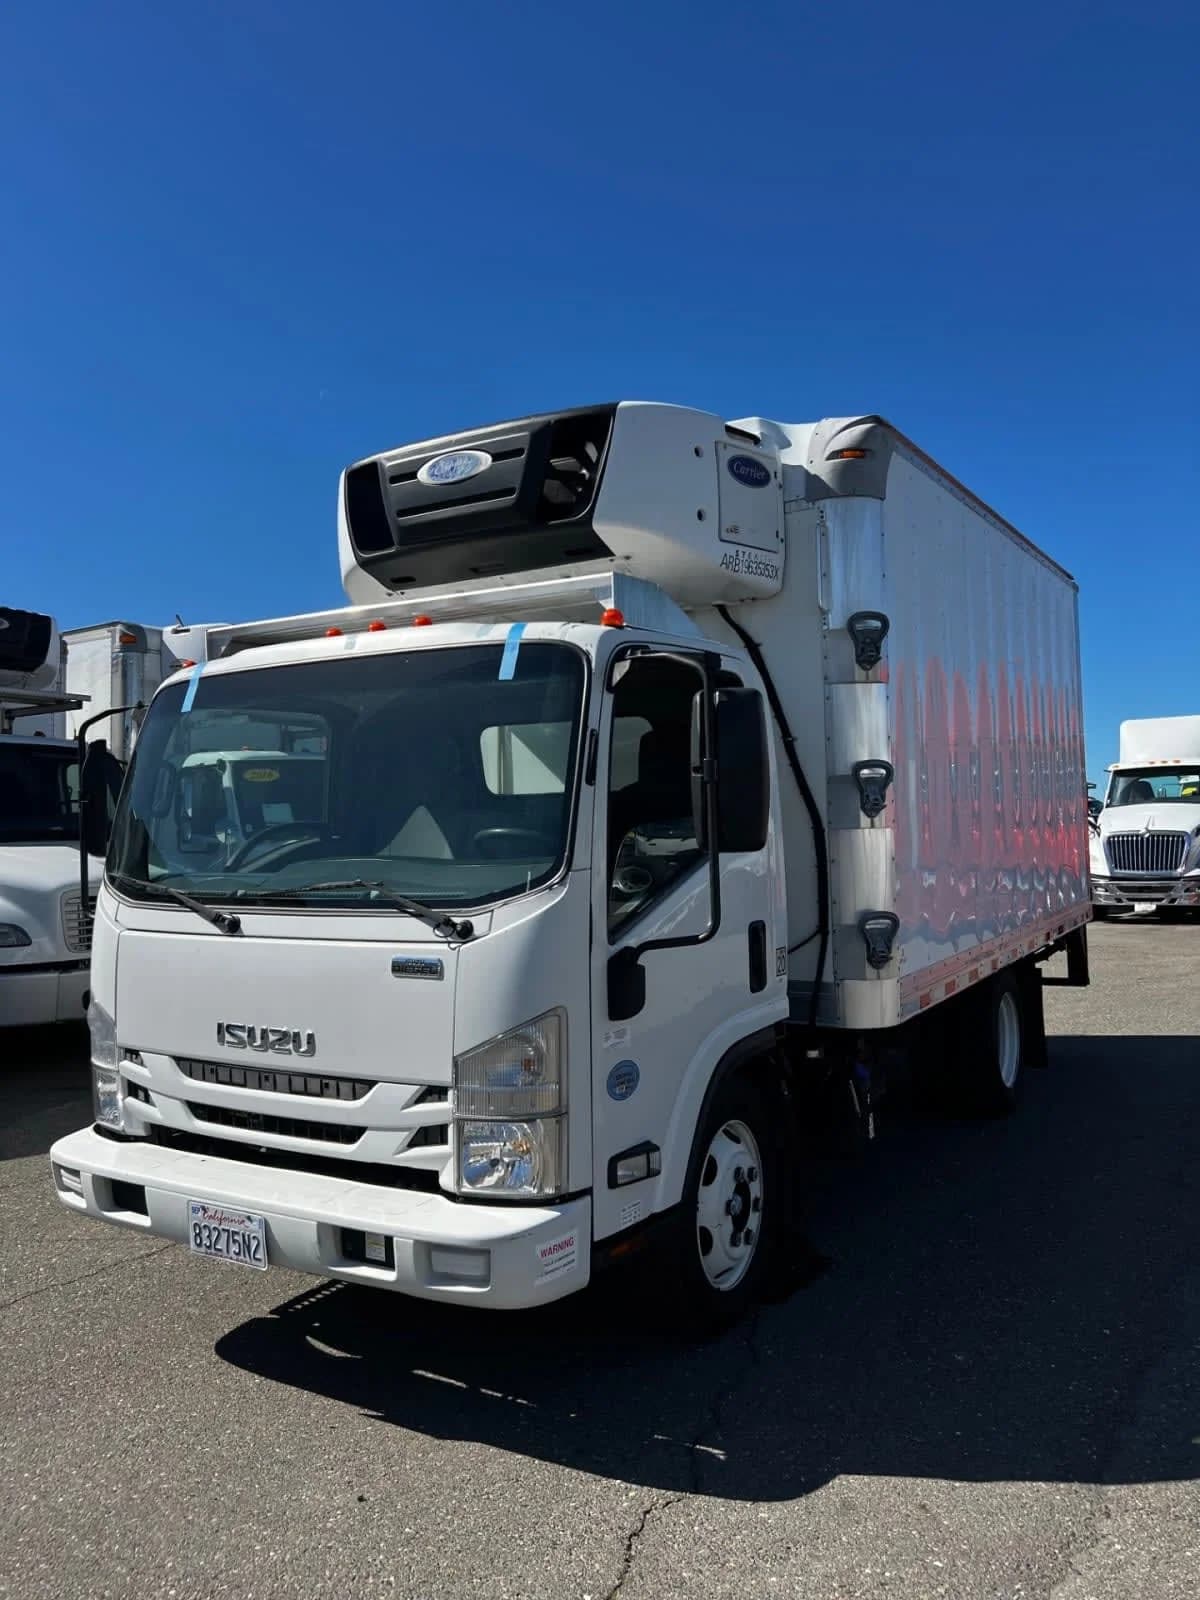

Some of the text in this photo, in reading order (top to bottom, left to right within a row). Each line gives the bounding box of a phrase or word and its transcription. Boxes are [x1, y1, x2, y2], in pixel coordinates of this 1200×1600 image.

[733, 461, 766, 480] Carrier
[217, 1022, 316, 1057] ISUZU
[202, 1208, 249, 1228] California
[192, 1222, 262, 1262] 83275N2
[540, 1236, 574, 1258] WARNING
